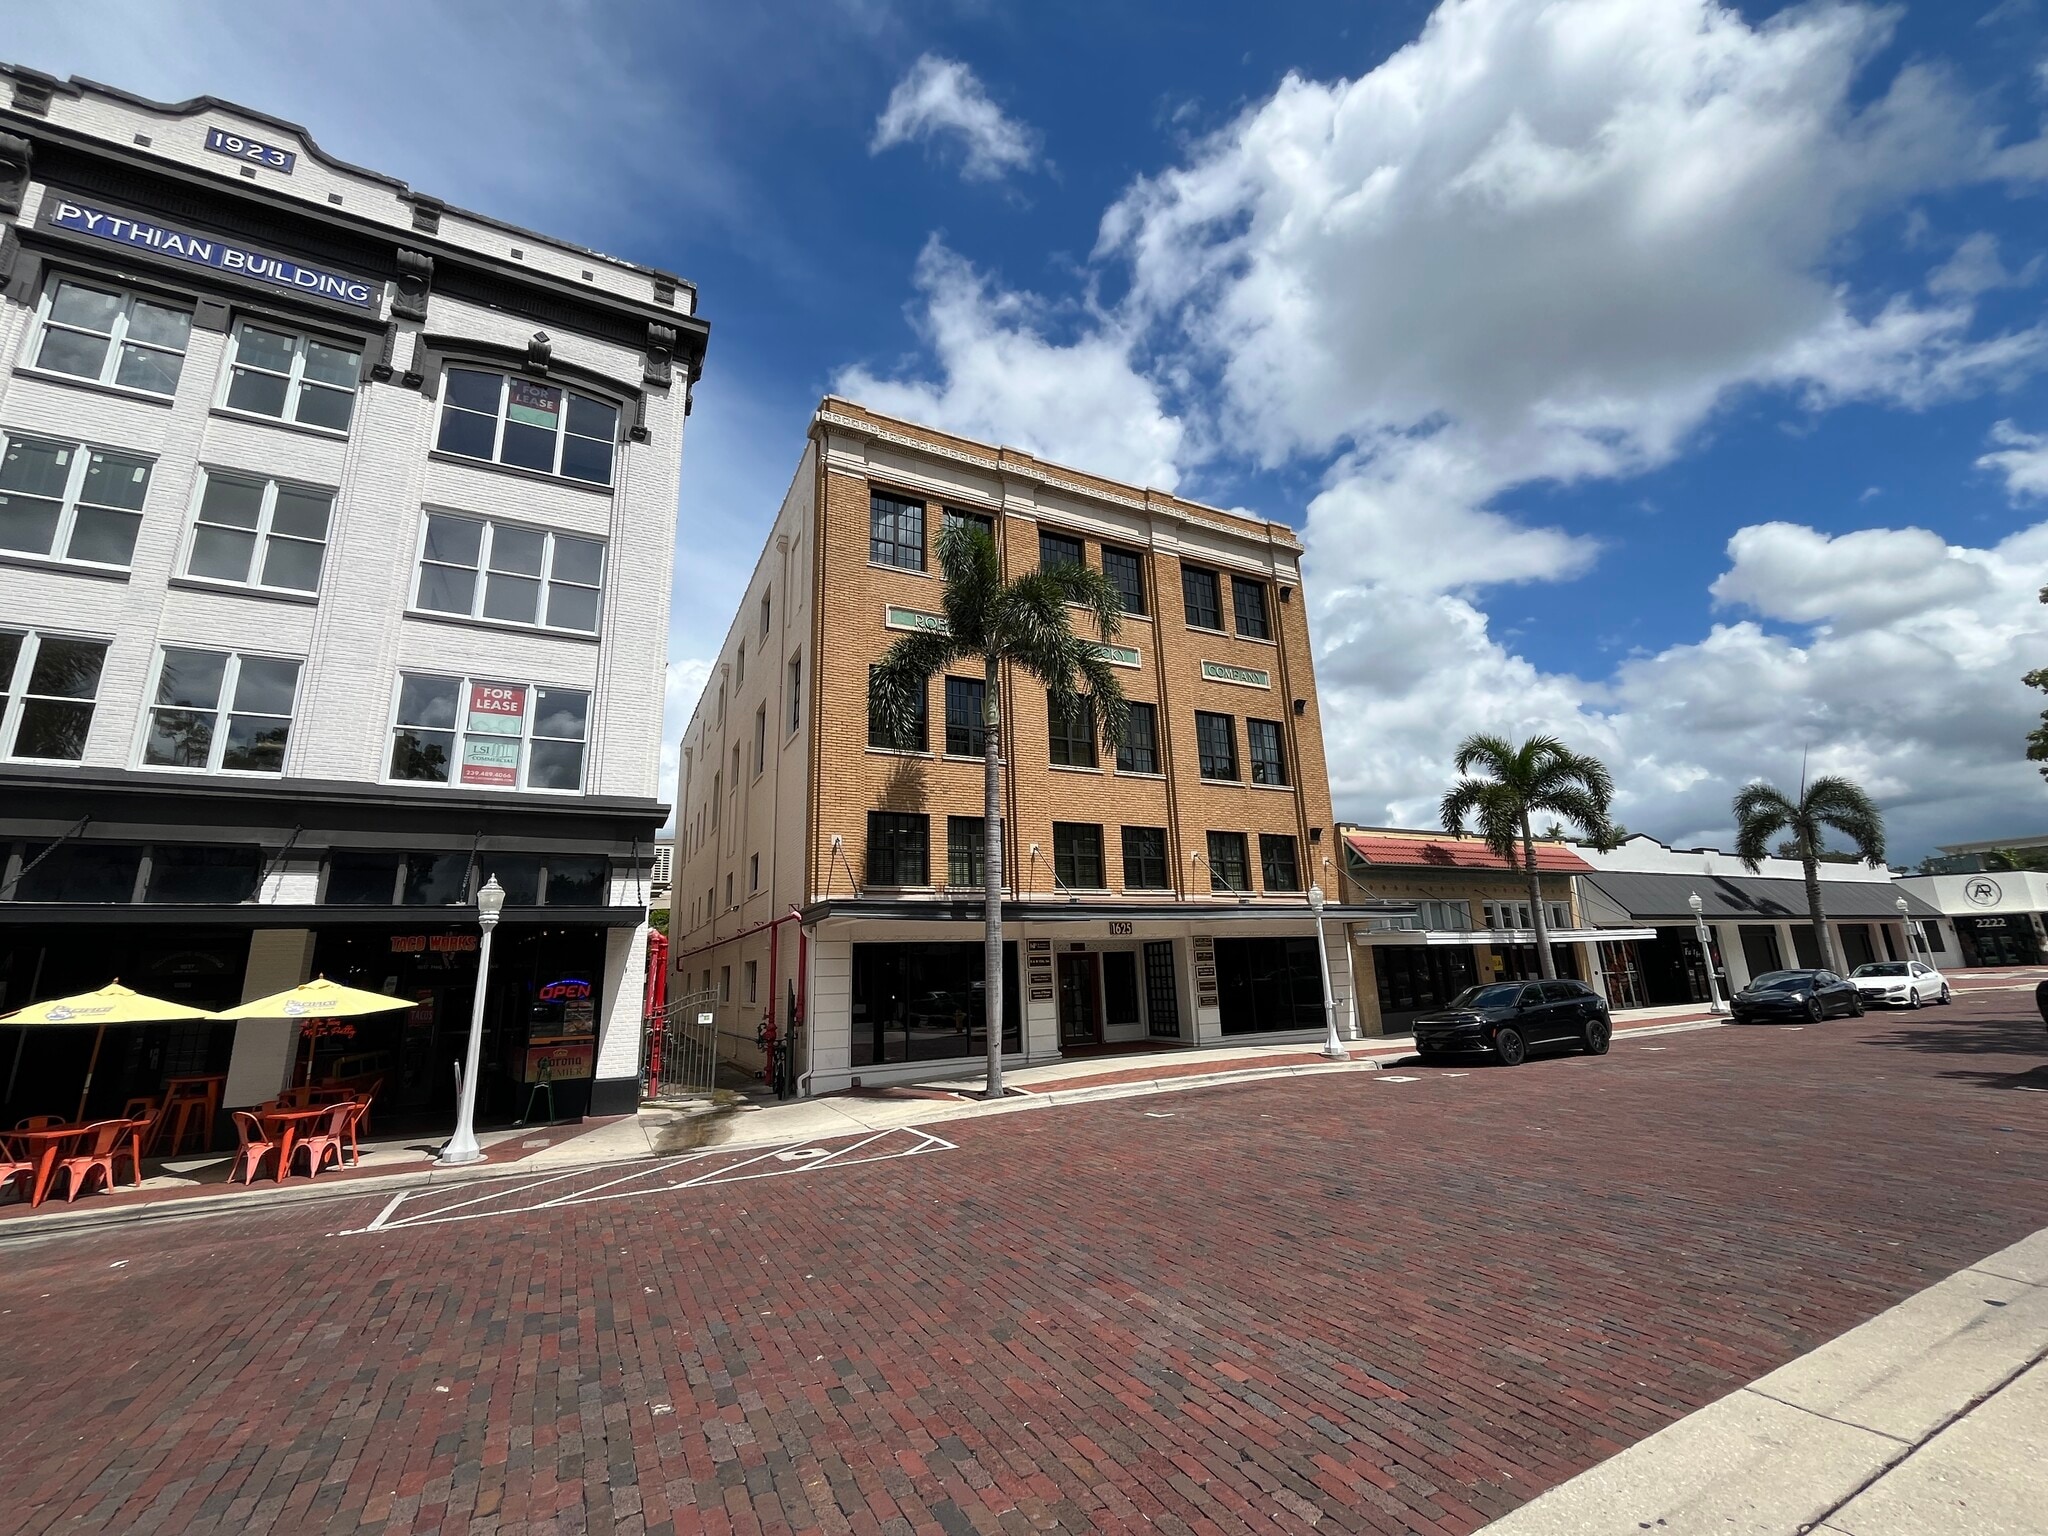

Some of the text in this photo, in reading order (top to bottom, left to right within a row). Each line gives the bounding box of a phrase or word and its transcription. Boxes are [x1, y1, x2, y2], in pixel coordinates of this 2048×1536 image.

[214, 132, 287, 167] 1923
[56, 202, 370, 302] PYTHIAN BUILDING
[522, 385, 549, 399] FOR
[516, 393, 554, 410] LEASE
[1208, 665, 1261, 684] COMPANY
[483, 687, 513, 700] FOR
[476, 698, 518, 712] LEASE
[472, 745, 490, 754] LSI
[1112, 922, 1131, 934] 1625
[1975, 918, 2007, 928] 2222
[391, 935, 477, 952] TACO WORKS
[539, 985, 591, 1000] OPEN
